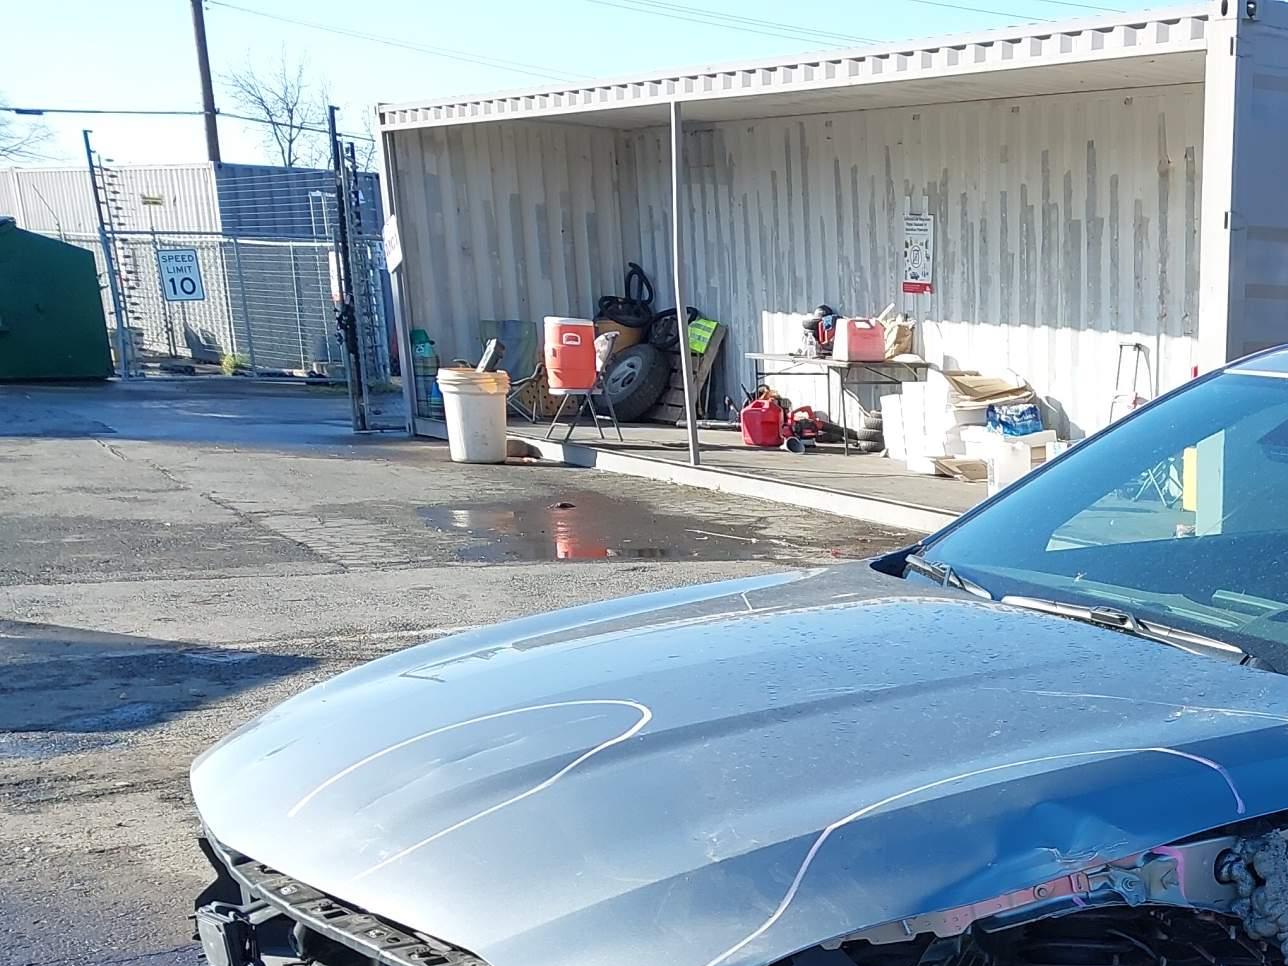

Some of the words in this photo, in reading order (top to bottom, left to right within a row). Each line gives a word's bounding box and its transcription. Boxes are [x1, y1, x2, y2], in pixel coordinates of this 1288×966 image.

[161, 255, 195, 263] SPEED
[166, 265, 193, 274] LIMIT
[169, 277, 197, 296] 10
